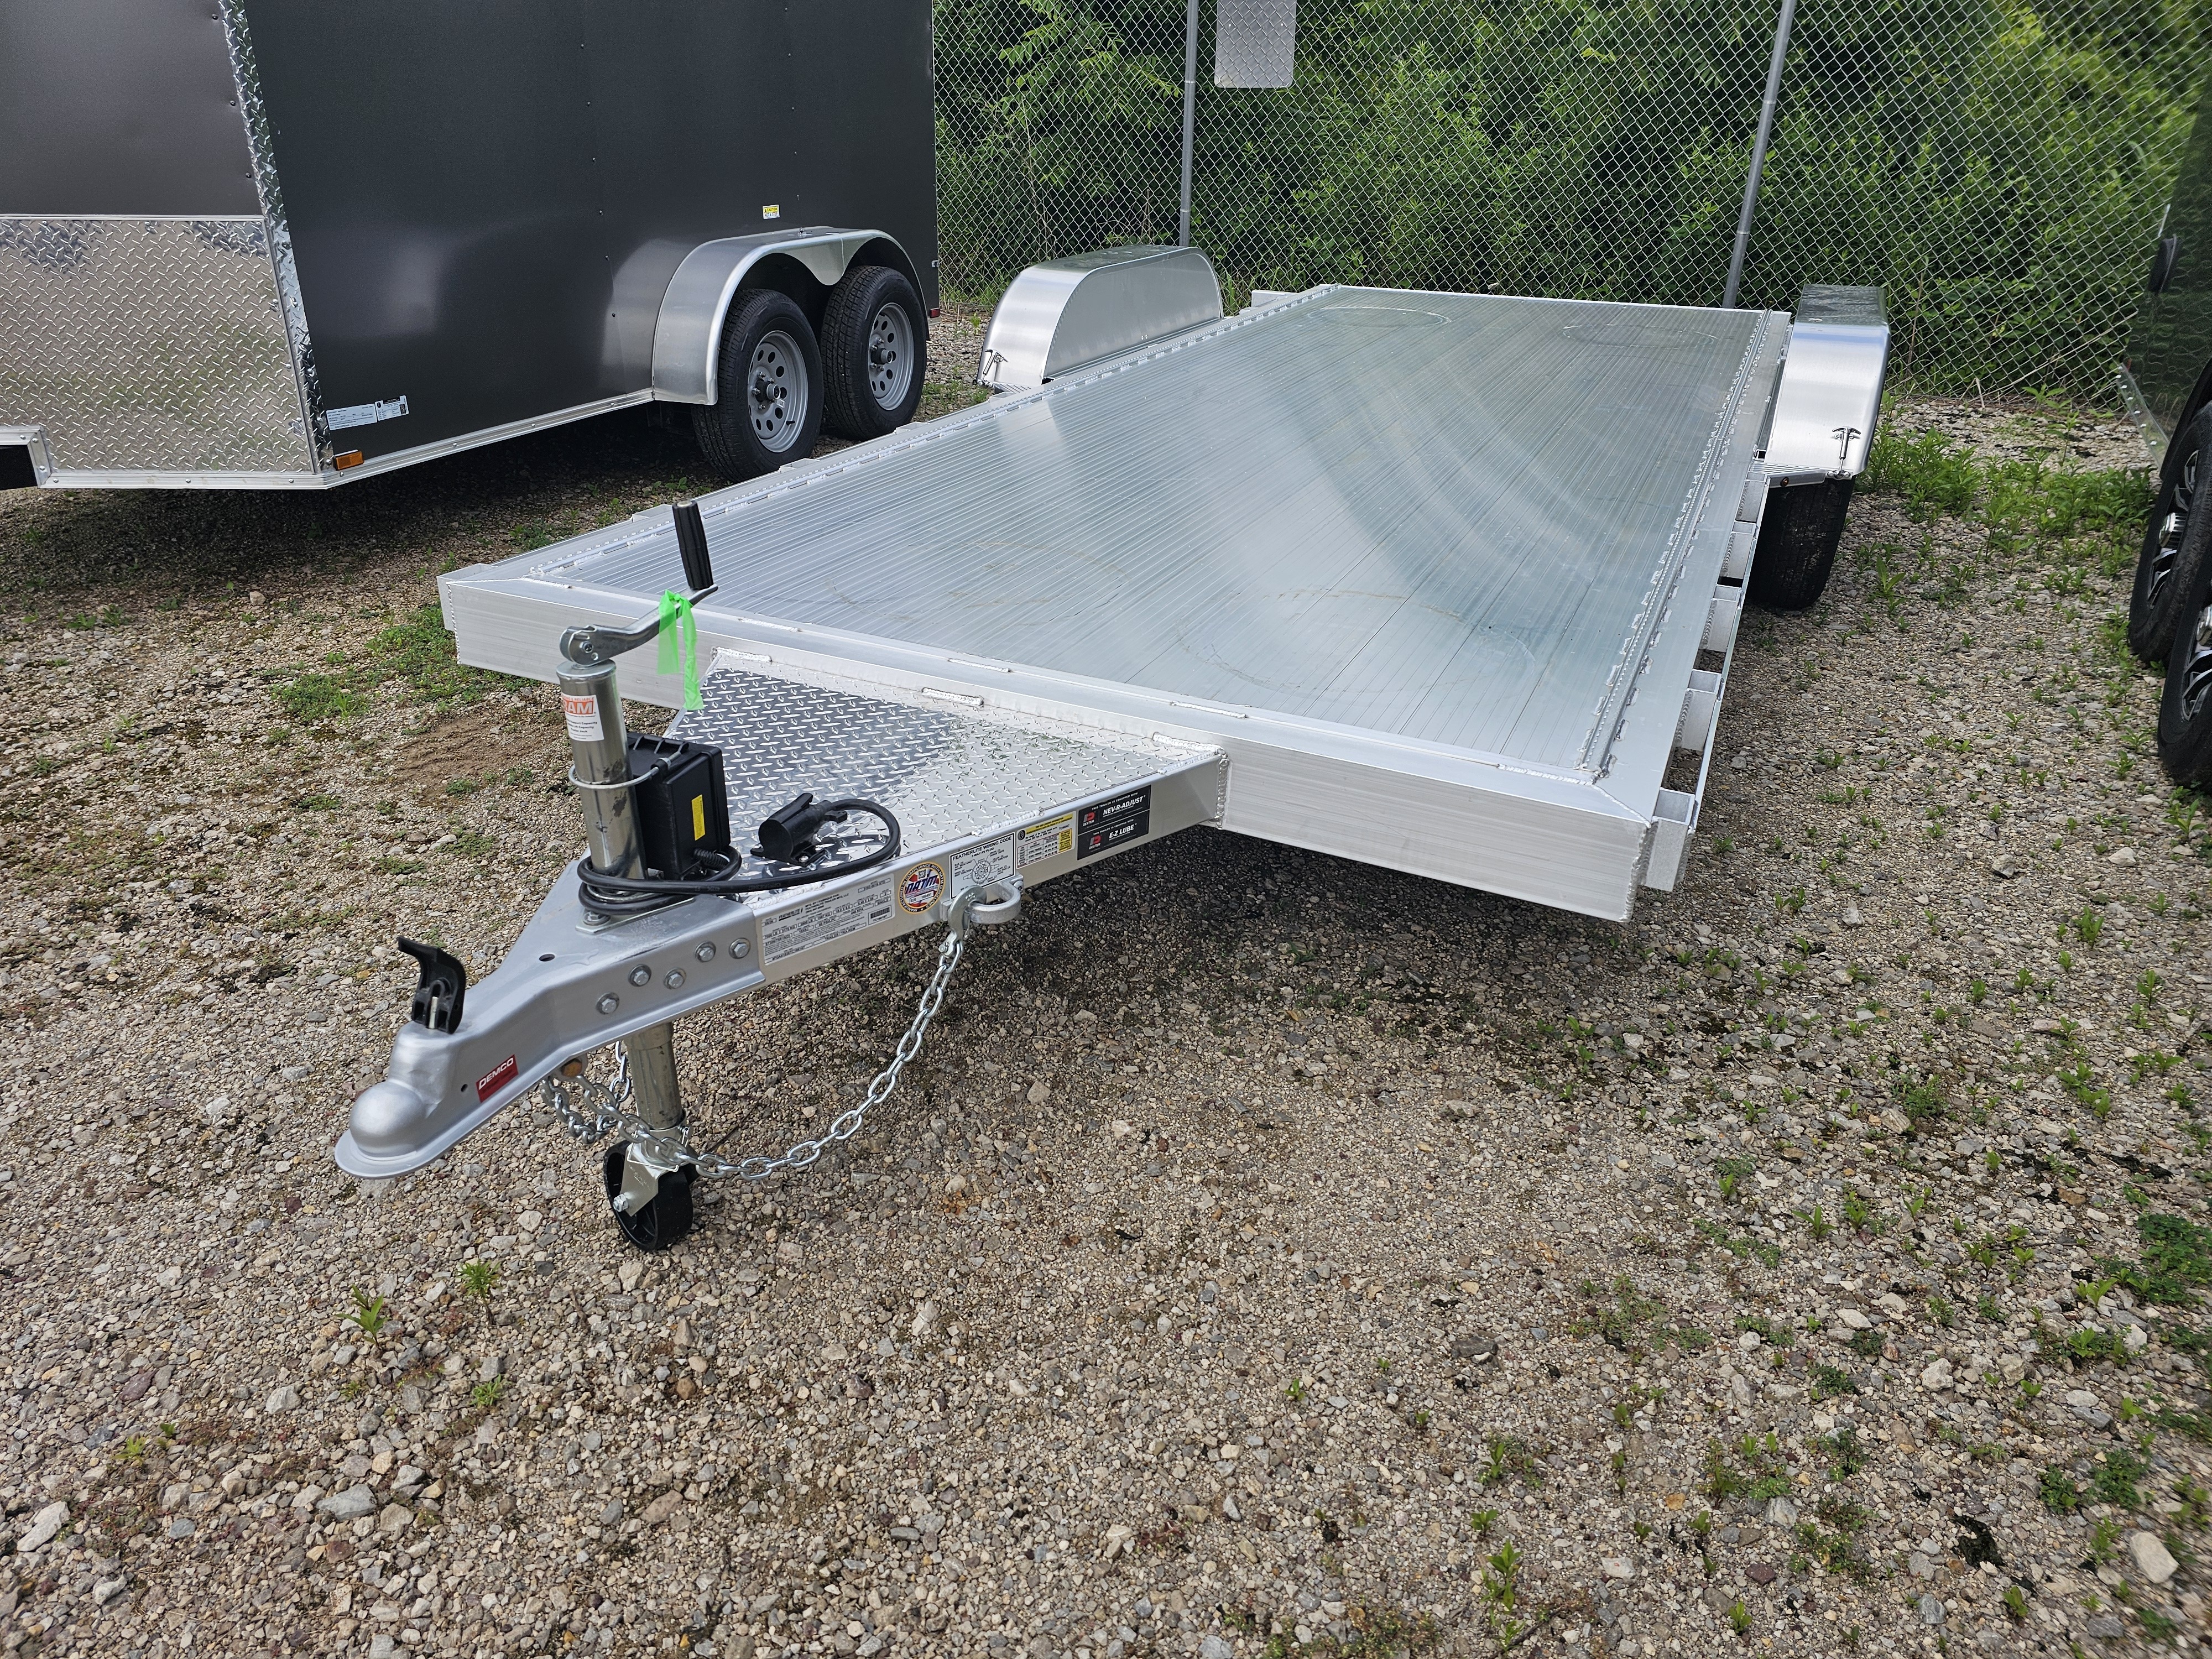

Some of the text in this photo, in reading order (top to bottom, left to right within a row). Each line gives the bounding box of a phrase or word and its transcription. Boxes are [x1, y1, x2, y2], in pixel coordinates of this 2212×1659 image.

[1109, 830, 1118, 838] E-Z
[1119, 823, 1134, 834] LUBE
[953, 846, 982, 860] FEATHERLITE
[983, 841, 998, 849] WIRING
[905, 864, 930, 880] COMPLIANCE
[805, 901, 824, 911] FEATHERLITE
[479, 1057, 514, 1090] DEMCO
